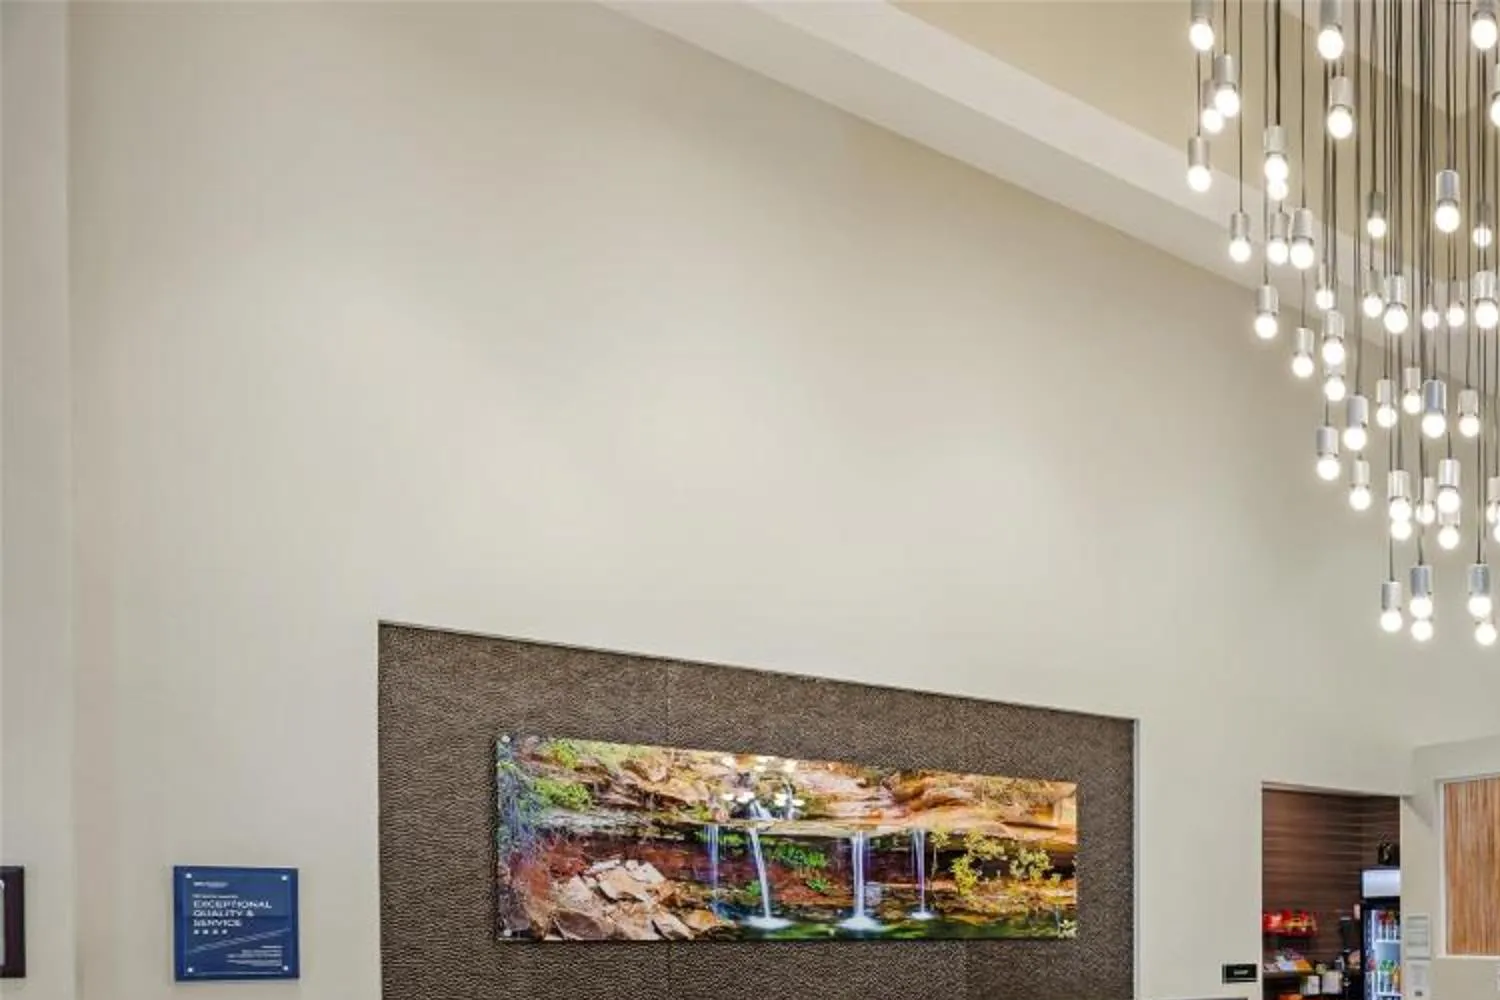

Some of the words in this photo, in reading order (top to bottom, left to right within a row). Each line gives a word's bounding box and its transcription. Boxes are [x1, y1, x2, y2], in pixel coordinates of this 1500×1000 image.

[193, 899, 273, 909] EXCEPTIONAL
[192, 909, 243, 917] QUALITY
[246, 909, 255, 917] &
